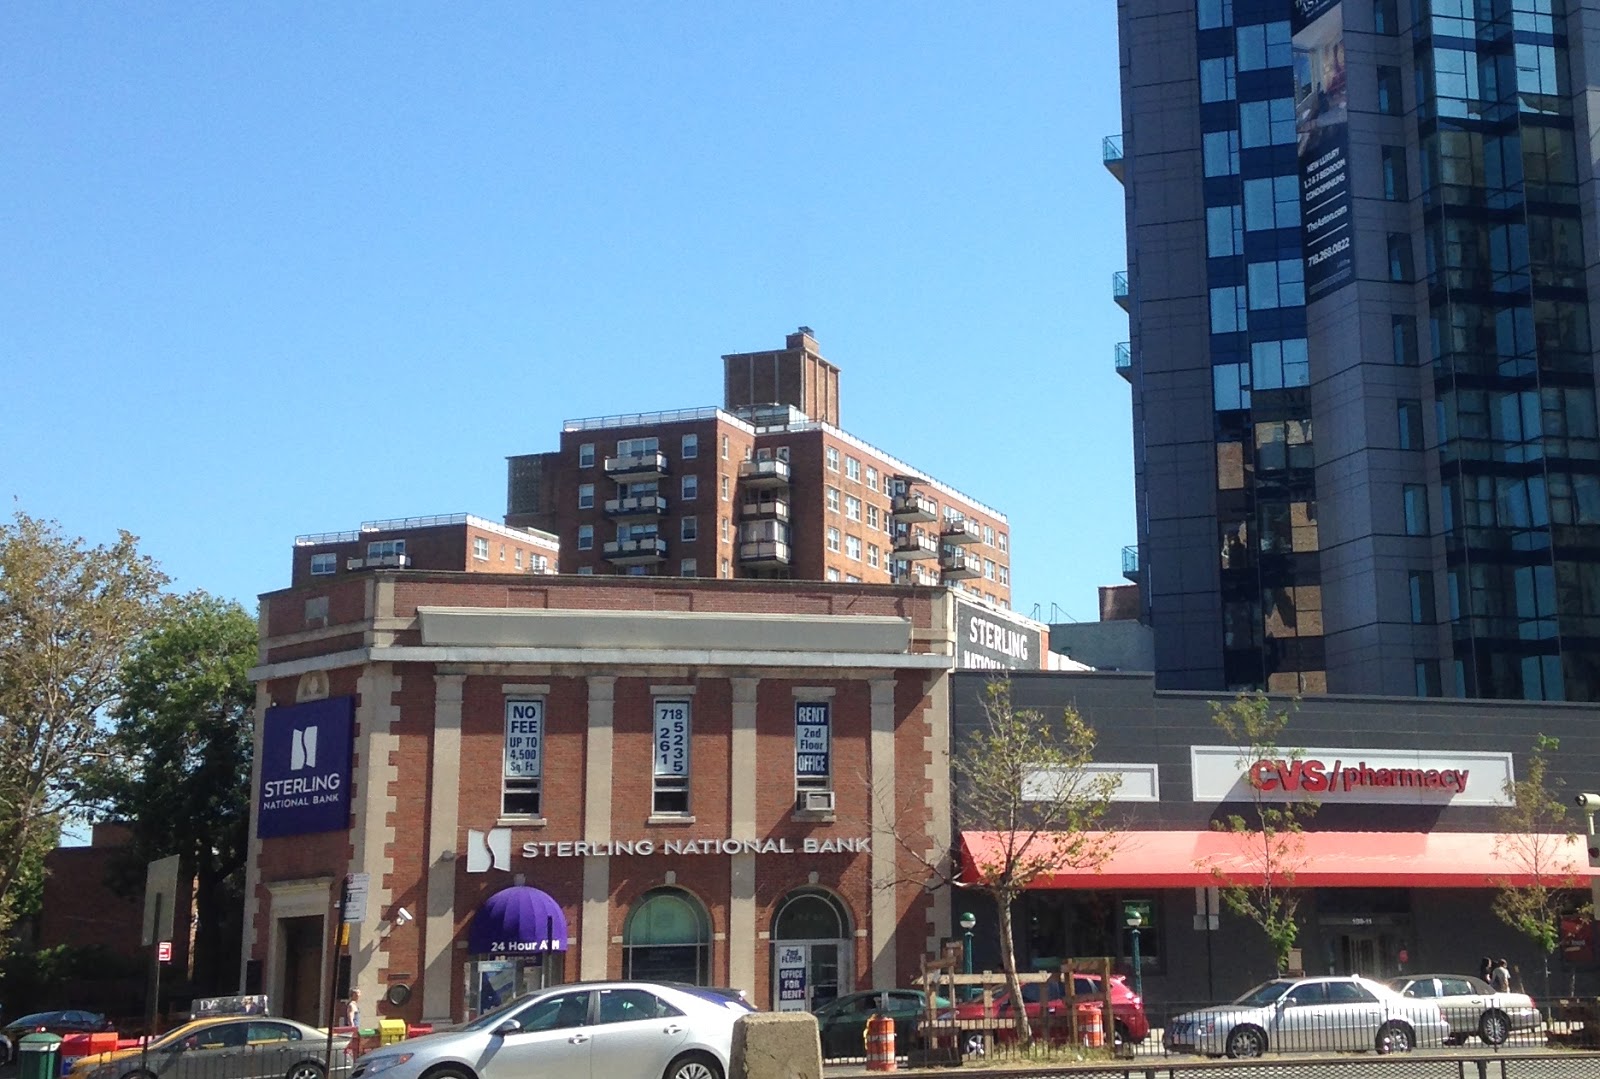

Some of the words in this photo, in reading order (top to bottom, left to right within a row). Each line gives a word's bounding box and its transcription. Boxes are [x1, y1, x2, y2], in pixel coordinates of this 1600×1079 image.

[1320, 158, 1346, 180] BEDROOM
[1305, 172, 1346, 201] CONDOMINIUMS
[969, 616, 1028, 661] STERLING
[513, 705, 536, 719] NO
[661, 709, 683, 720] 718
[798, 706, 826, 723] RENT
[511, 721, 537, 733] FEE
[804, 728, 821, 738] 2nd
[509, 736, 522, 748] UP
[525, 736, 538, 748] TO
[800, 740, 824, 750] Floor
[510, 749, 536, 761] 4,500
[798, 755, 825, 771] OFFICE
[264, 773, 341, 798] STERLING
[263, 797, 309, 810] NATIONAL
[312, 793, 339, 804] BANK
[522, 839, 655, 858] STERLING
[664, 837, 795, 856] NATIONAL
[803, 837, 873, 854] BANK
[491, 942, 505, 952] 24
[509, 941, 537, 951] Hour
[539, 939, 560, 950] AM
[781, 969, 803, 979] OFFICE
[784, 980, 800, 989] FOR
[782, 990, 802, 999] RENT
